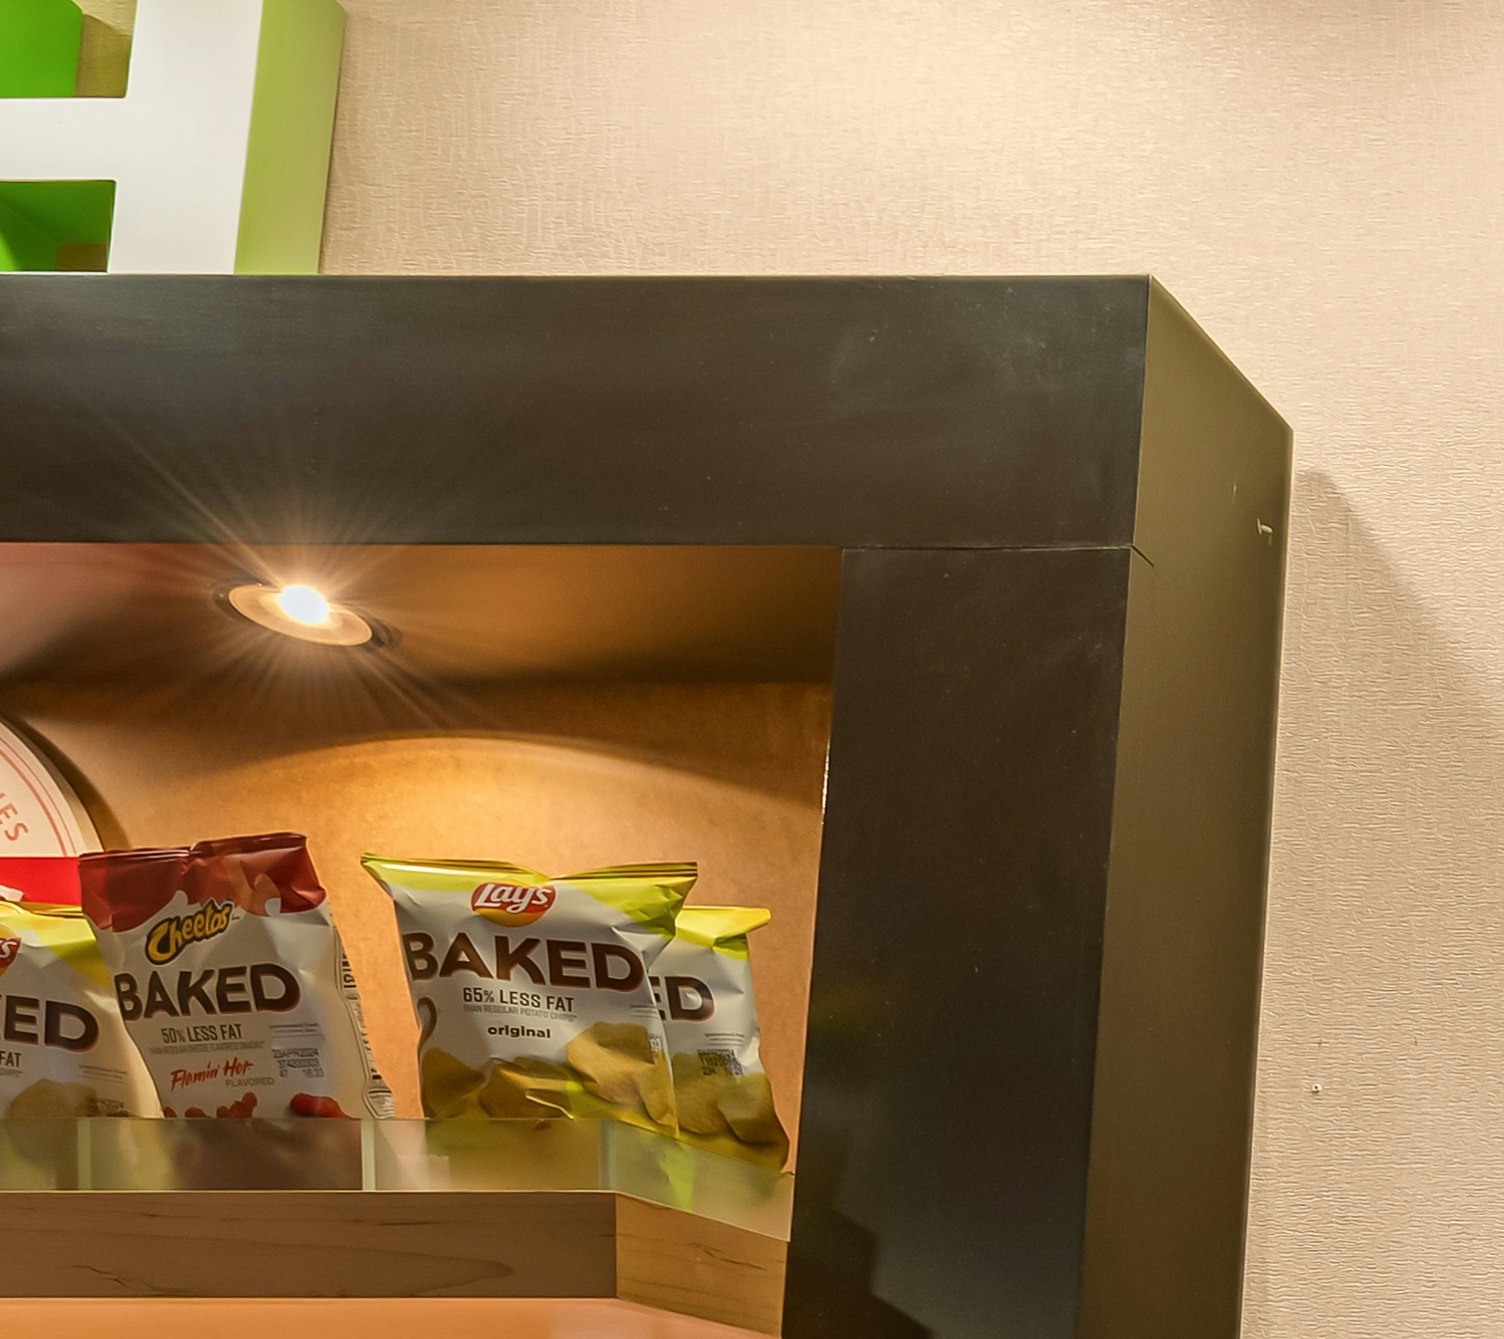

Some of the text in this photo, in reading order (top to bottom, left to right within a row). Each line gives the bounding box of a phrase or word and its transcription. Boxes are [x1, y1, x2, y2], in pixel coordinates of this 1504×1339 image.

[147, 899, 232, 965] Cheetos
[402, 932, 645, 992] BAKED
[114, 963, 301, 1021] BAKED
[463, 987, 575, 1012] 65% LESS FAT
[161, 1024, 242, 1043] 50% LESS FAT
[487, 1024, 551, 1039] original
[223, 1056, 254, 1077] Hot
[226, 1077, 275, 1087] FLAVORED
